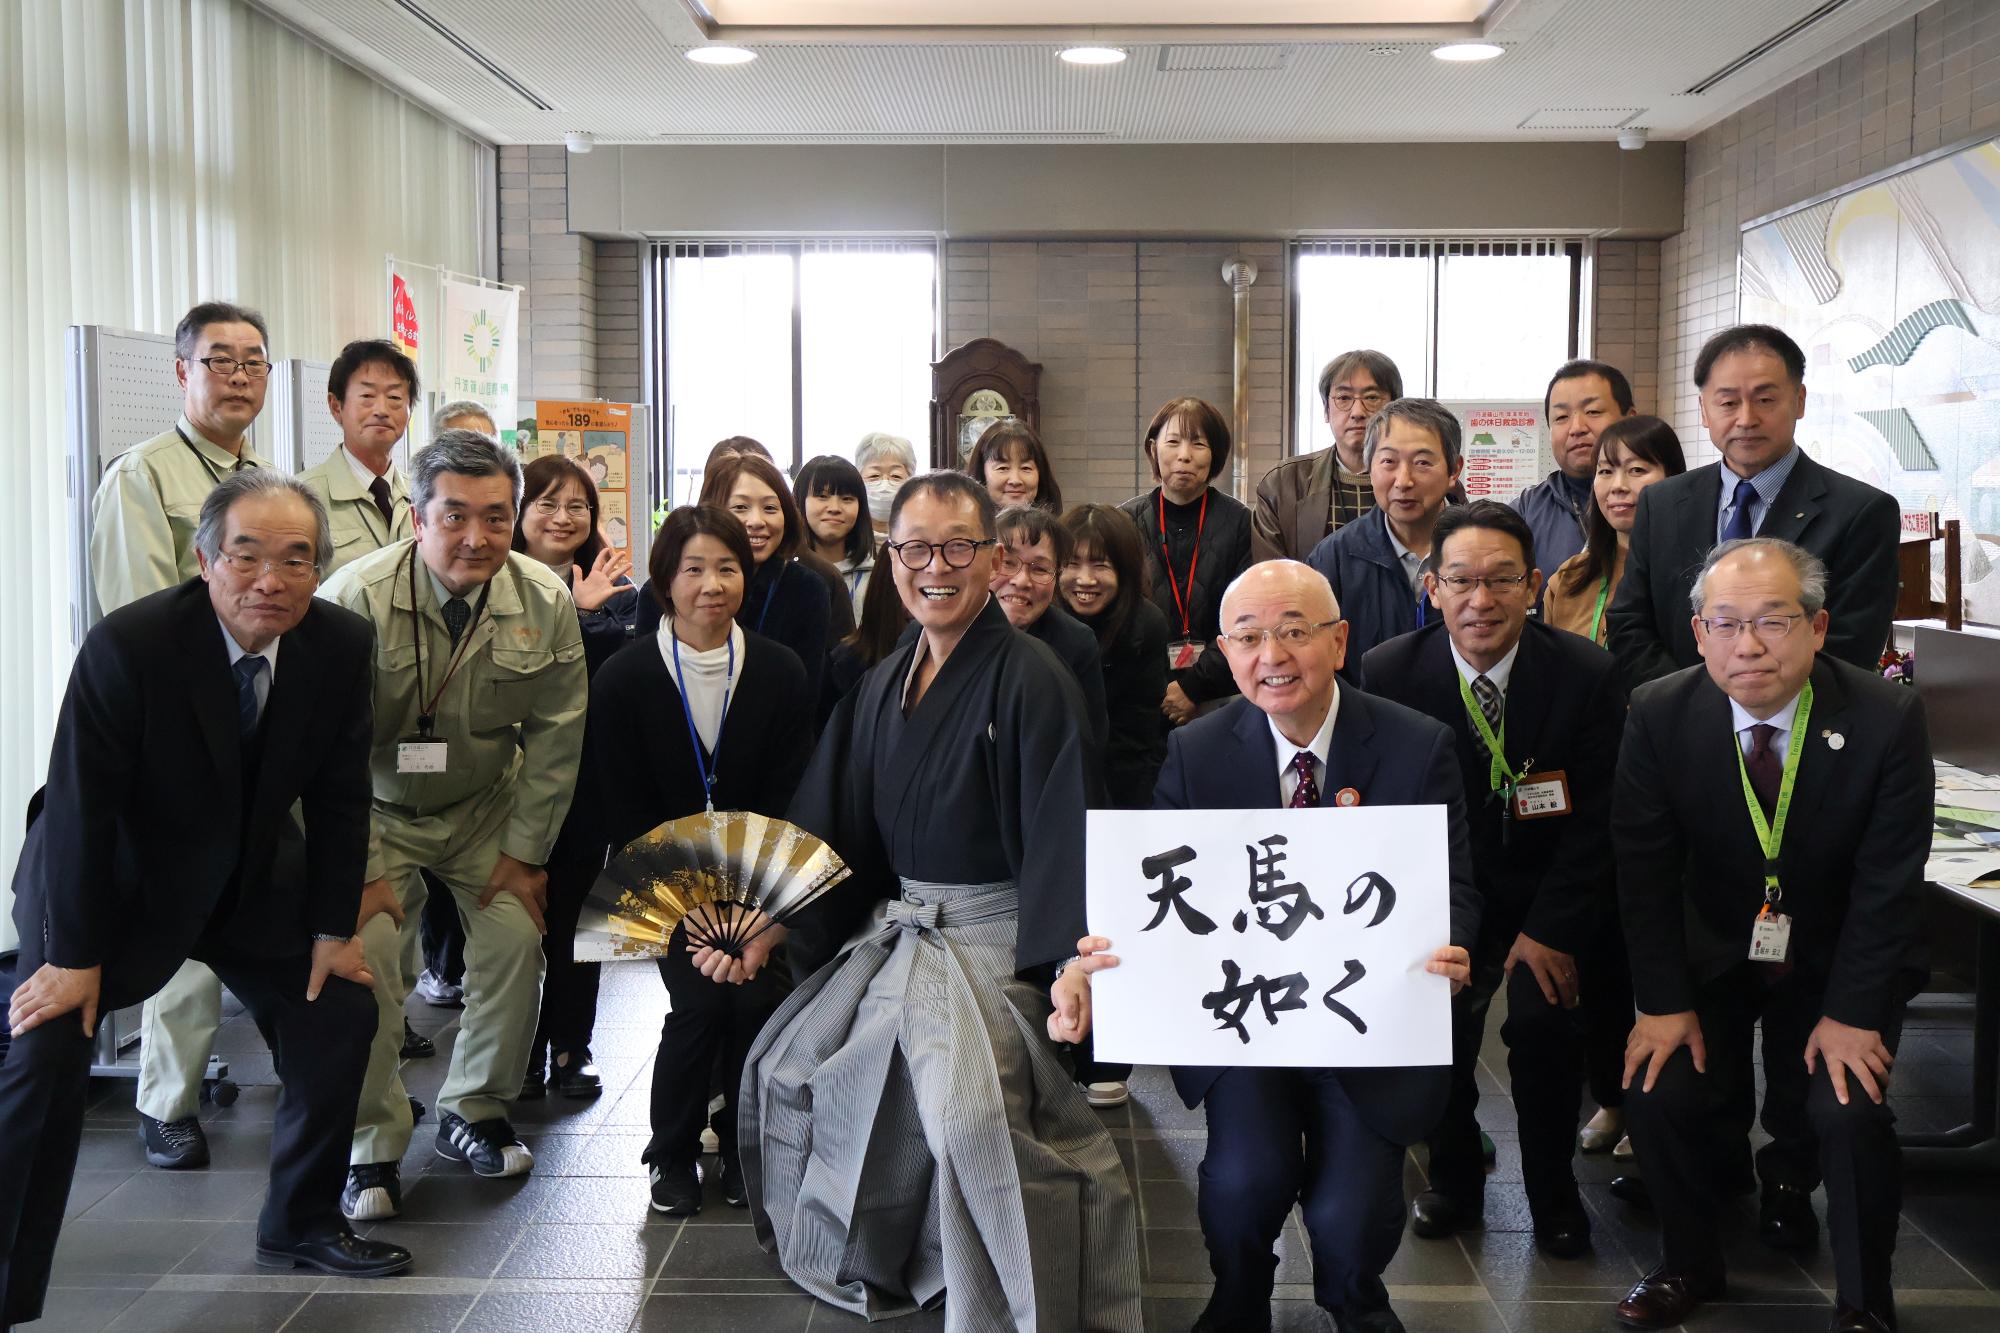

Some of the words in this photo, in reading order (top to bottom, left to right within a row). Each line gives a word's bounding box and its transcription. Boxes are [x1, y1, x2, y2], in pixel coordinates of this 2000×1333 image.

[568, 414, 590, 426] 189
[1470, 418, 1535, 427] 歯の休日救急診療
[1138, 834, 1397, 941] 天馬の
[1201, 959, 1368, 1044] 如く
